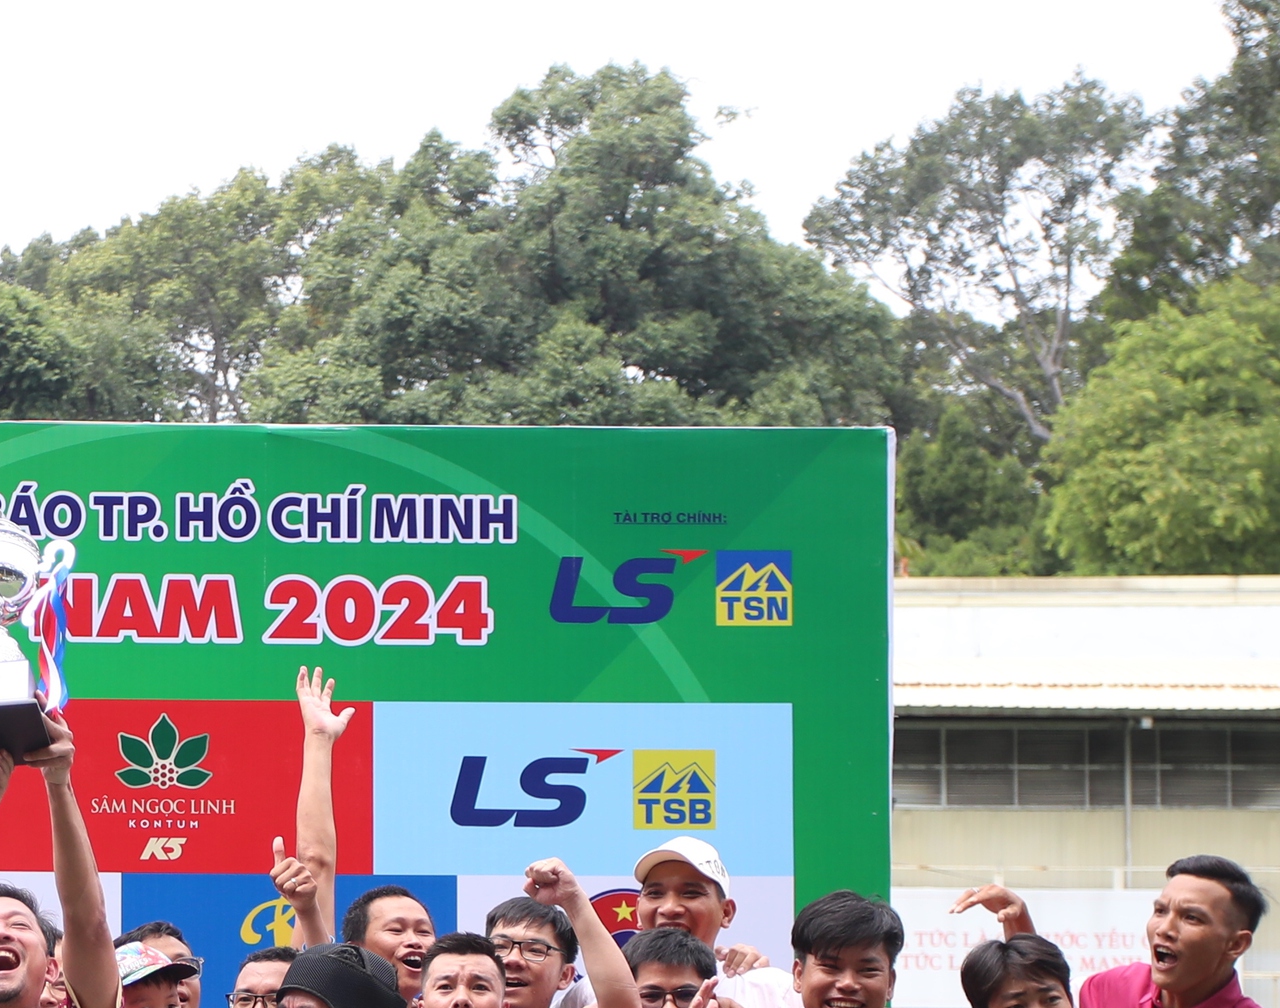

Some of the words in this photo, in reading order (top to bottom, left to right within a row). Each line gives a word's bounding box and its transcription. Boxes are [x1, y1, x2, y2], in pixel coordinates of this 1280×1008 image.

[91, 492, 168, 541] TP.
[176, 478, 258, 544] HỒ
[266, 483, 364, 544] CHÍ
[370, 494, 518, 545] MINH
[613, 509, 638, 523] TÀI
[642, 510, 671, 524] TRỢ
[675, 510, 728, 524] CHÍNH:
[549, 556, 676, 624] LS
[29, 574, 243, 645] NAM
[263, 574, 495, 646] 2024
[720, 596, 788, 621] TSN
[450, 755, 589, 828] LS
[90, 795, 126, 815] SÂM
[131, 799, 187, 818] NGỌC
[190, 799, 236, 816] LINH
[638, 798, 712, 825] TSB
[128, 819, 200, 829] KONTUM
[139, 837, 188, 861] K5
